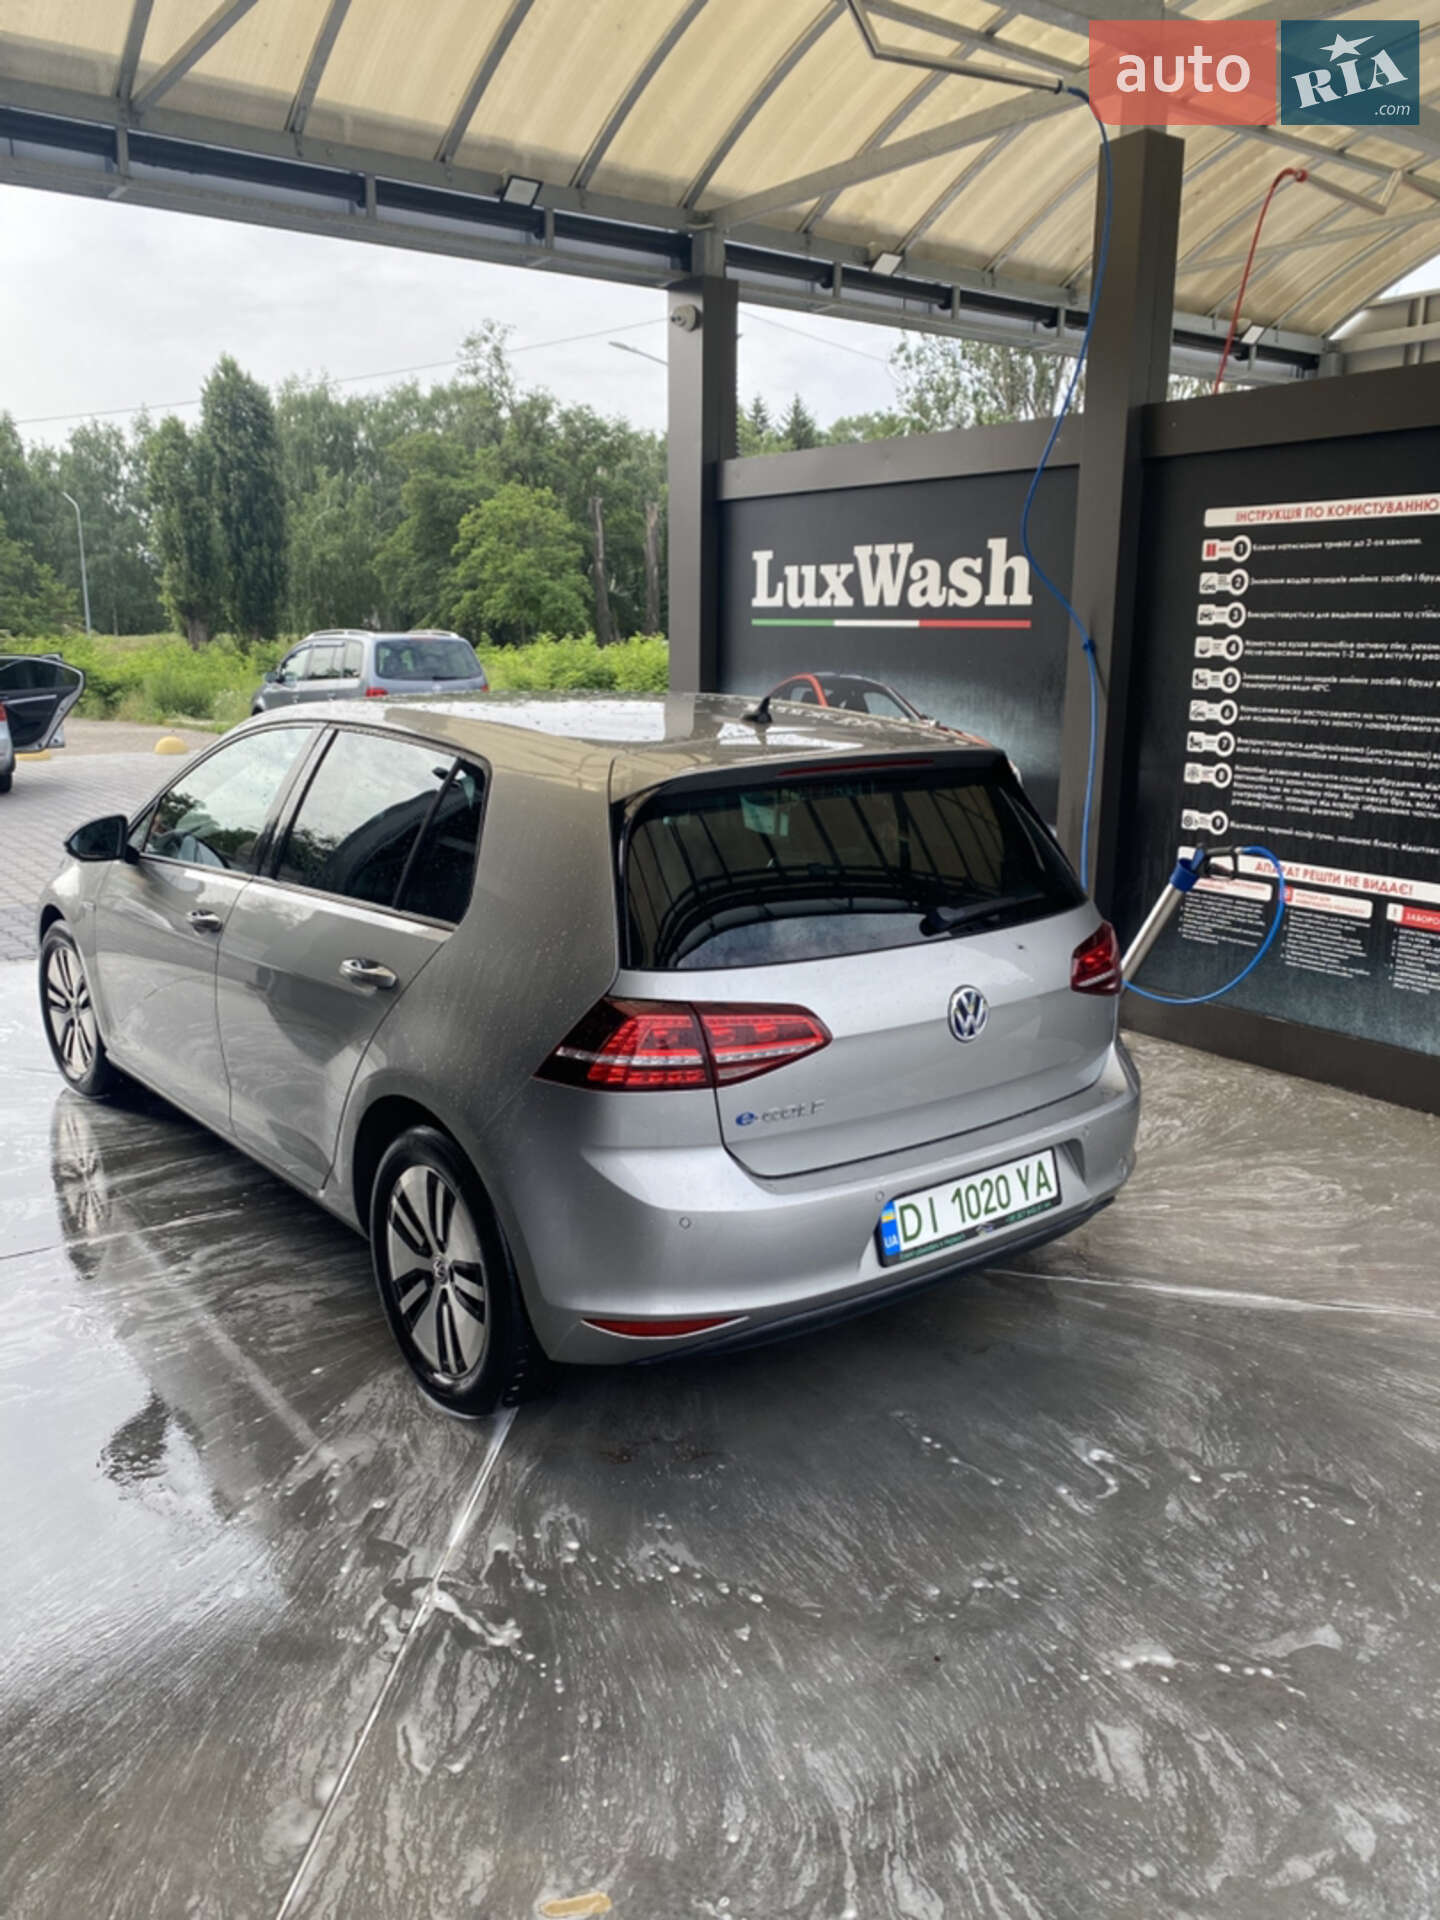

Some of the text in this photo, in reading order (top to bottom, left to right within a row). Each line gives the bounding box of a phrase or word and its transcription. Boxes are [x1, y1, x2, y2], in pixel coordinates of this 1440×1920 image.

[1305, 505, 1324, 519] ПО
[1327, 498, 1439, 517] КОРИСТУВАННЮ
[751, 537, 1032, 608] LuxWash
[1303, 868, 1341, 884] РЕШТИ
[1344, 874, 1360, 888] НЕ
[898, 1196, 938, 1243] DI
[951, 1173, 1011, 1224] 1020
[1016, 1159, 1052, 1201] YA
[884, 1234, 898, 1248] UA
